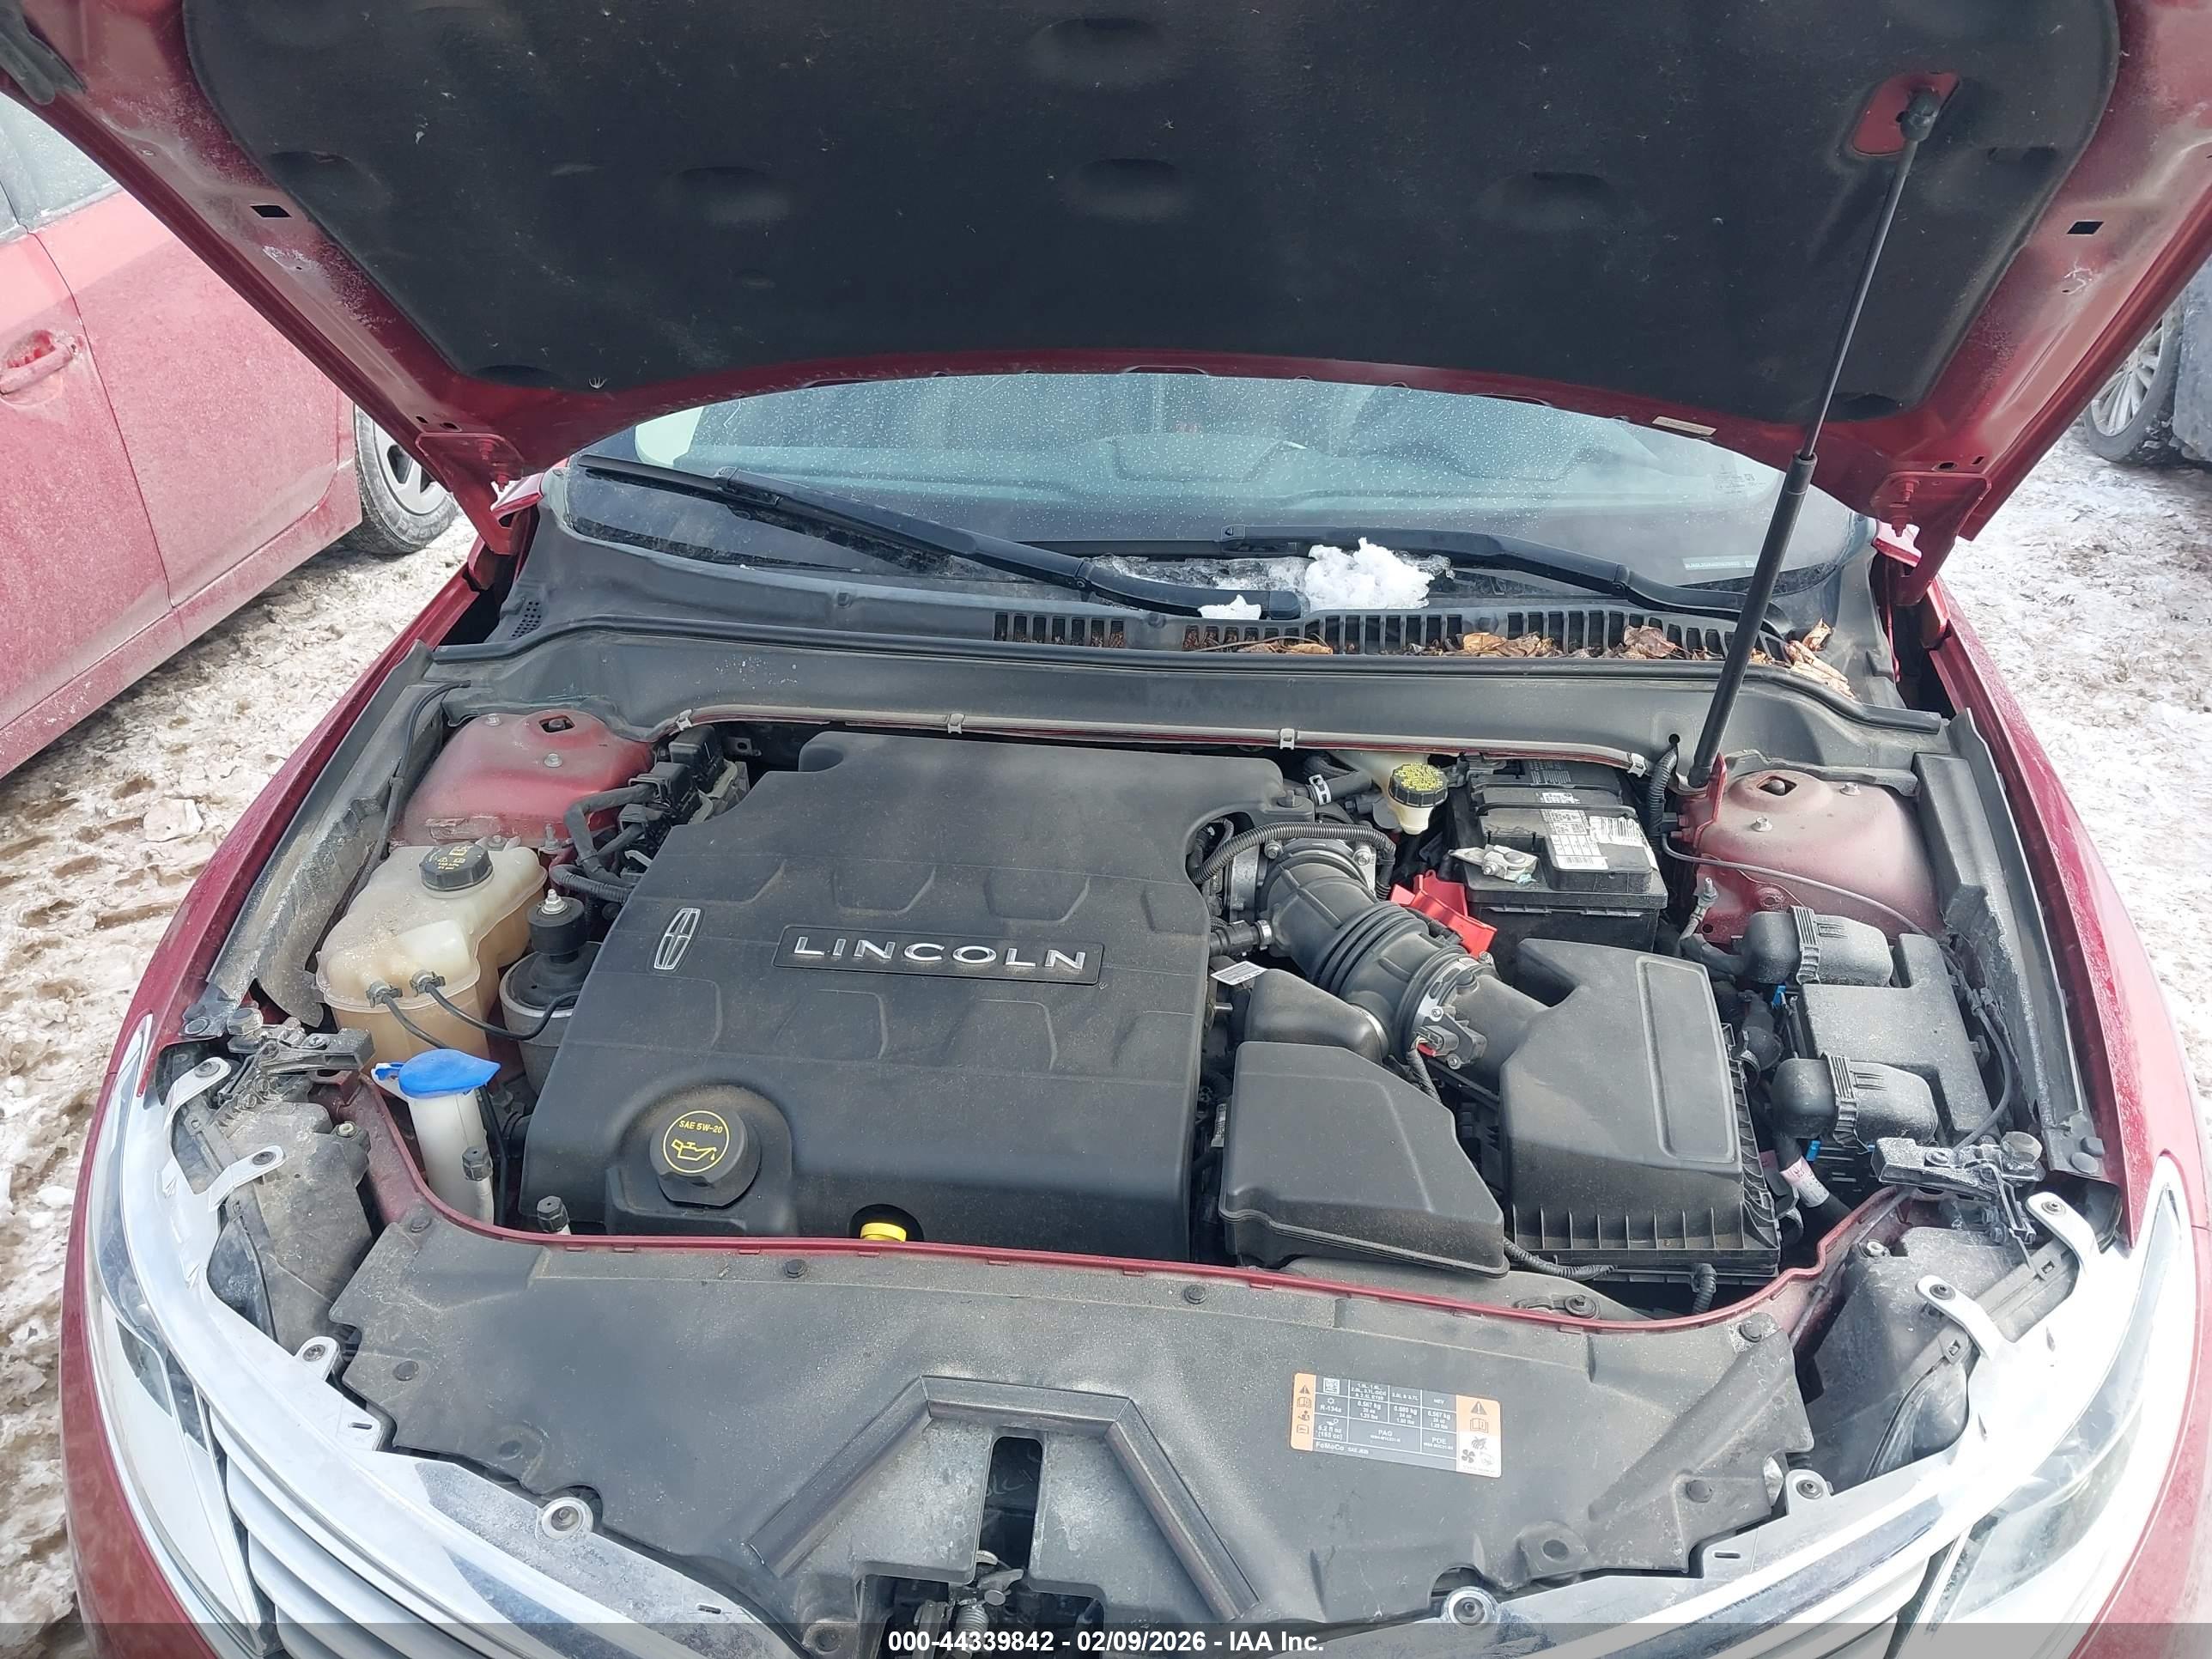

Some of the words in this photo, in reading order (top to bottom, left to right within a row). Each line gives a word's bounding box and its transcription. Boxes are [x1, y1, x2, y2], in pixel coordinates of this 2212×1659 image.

[793, 936, 1086, 969] LINCOLN
[678, 1121, 696, 1130] SAE
[696, 1122, 723, 1134] 5W-20
[1320, 1405, 1342, 1413] R-134a
[1410, 1407, 1418, 1416] kg
[1316, 1441, 1345, 1451] FoMoCo
